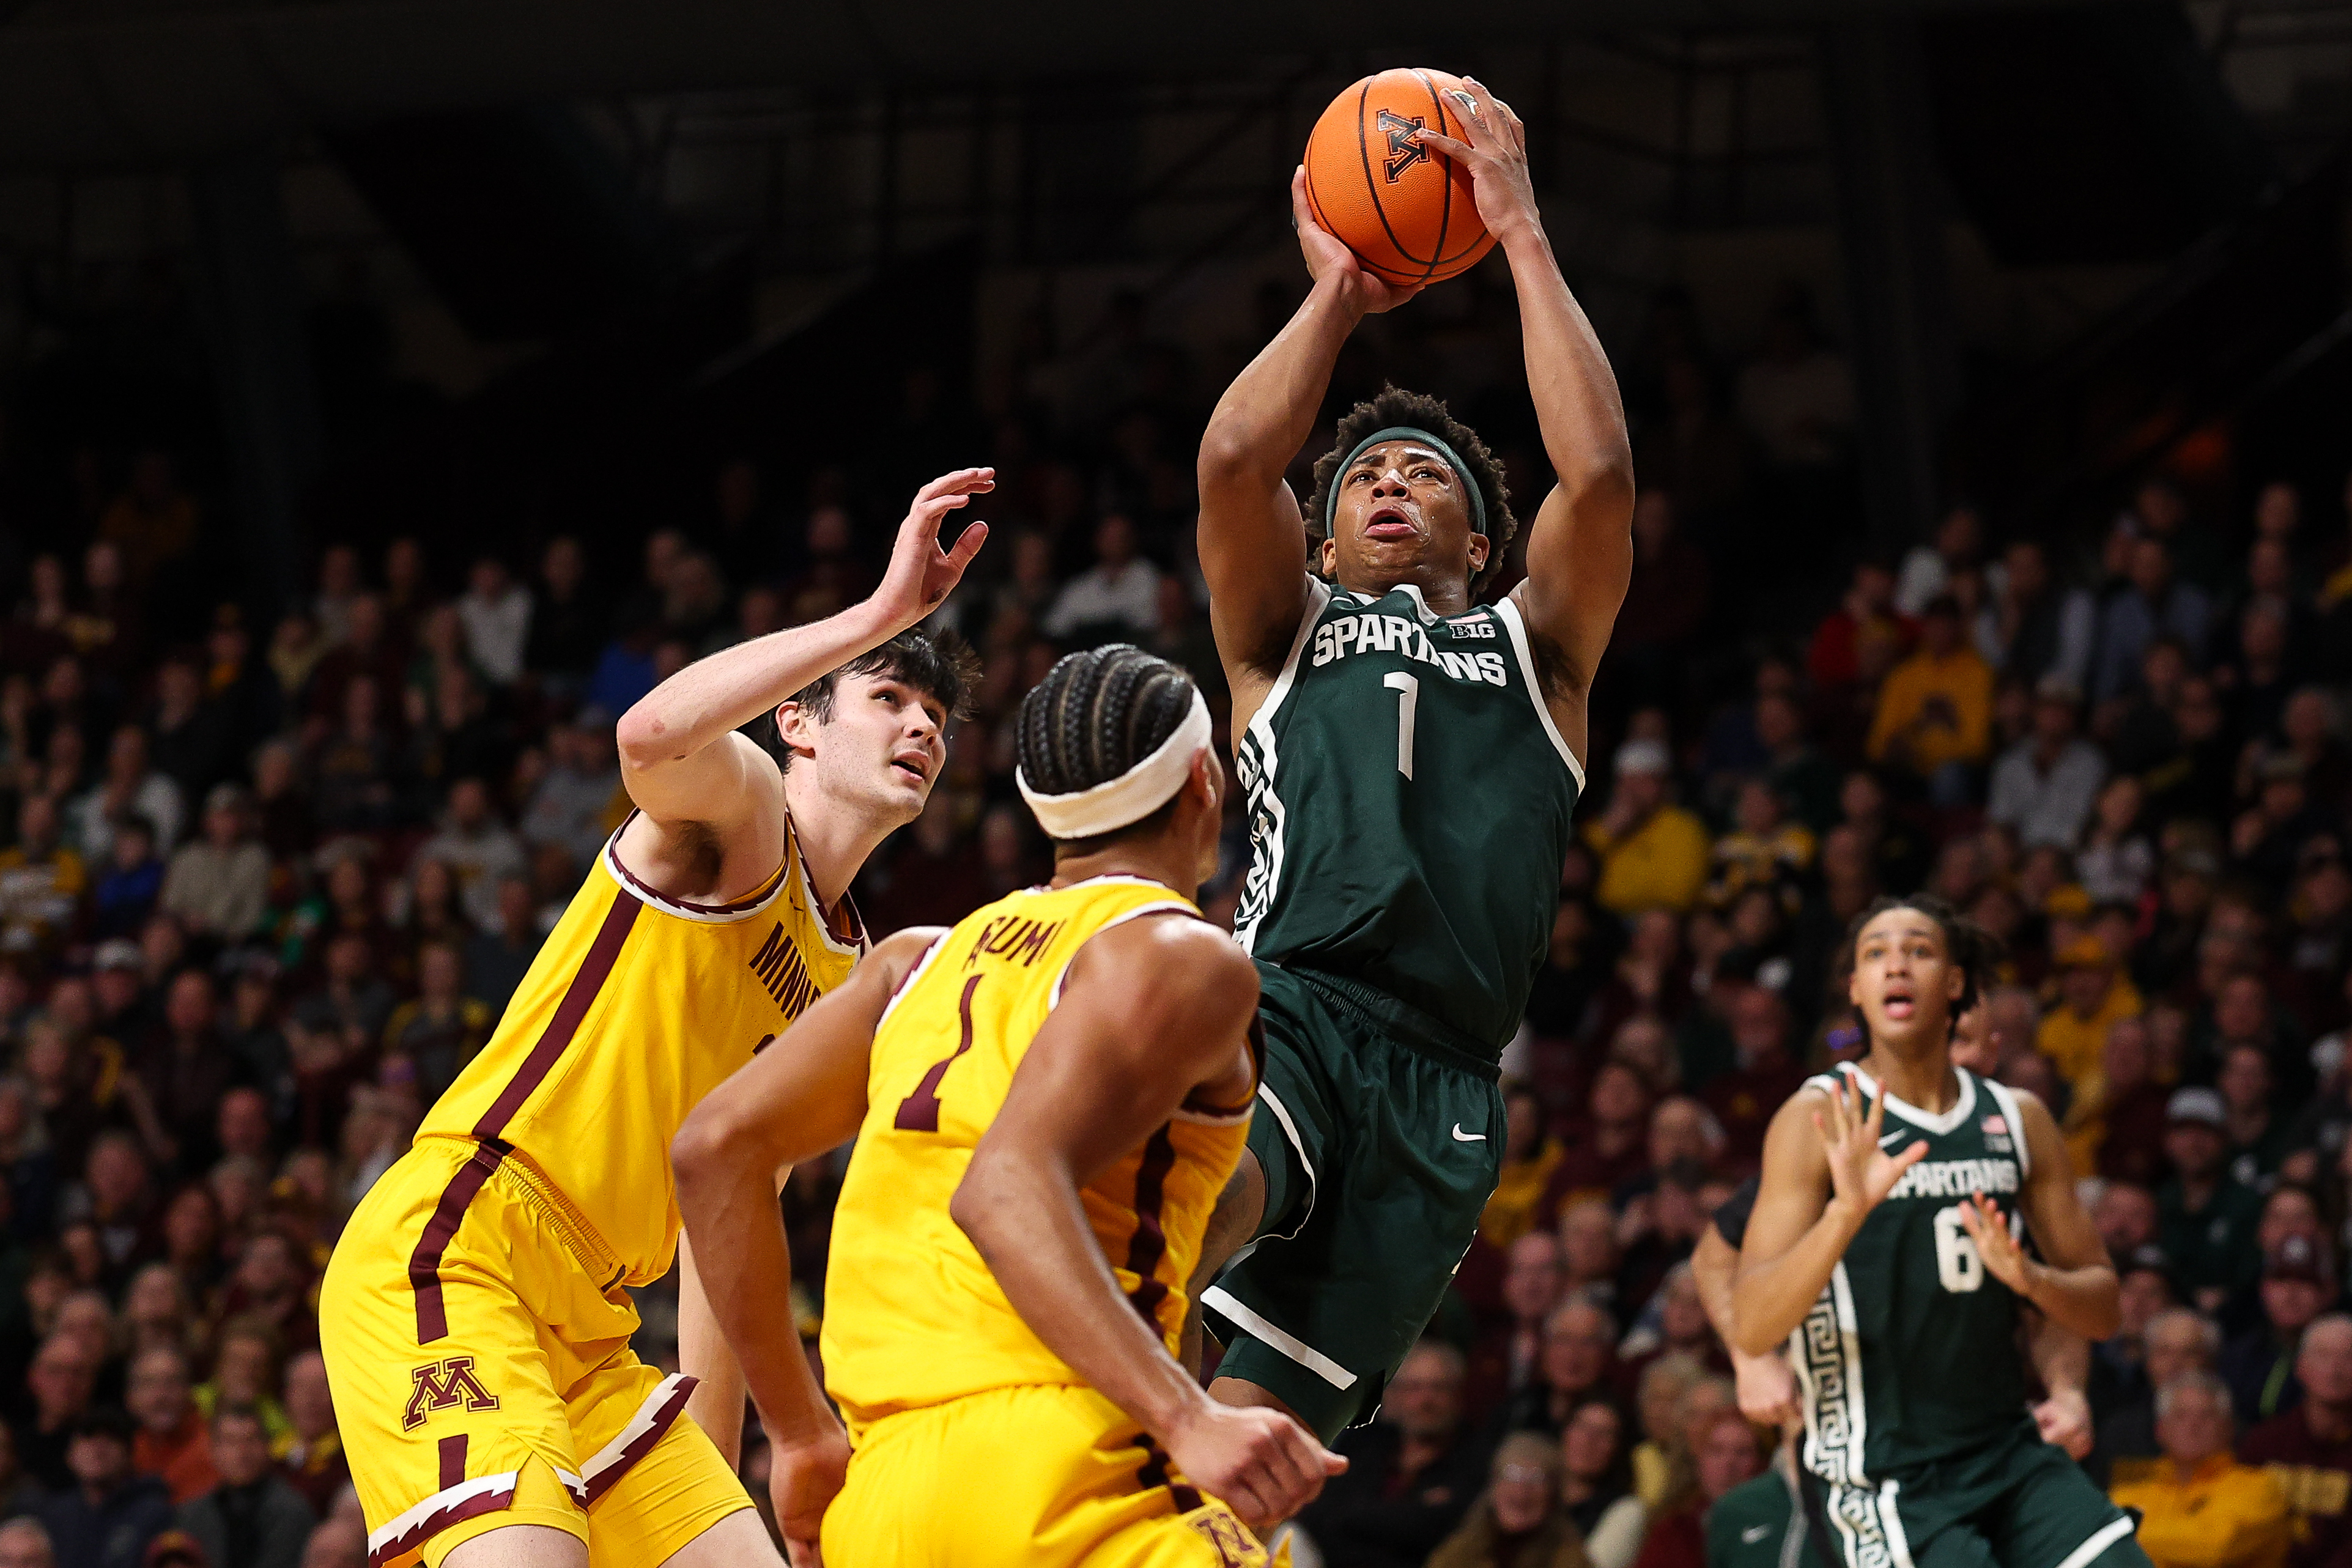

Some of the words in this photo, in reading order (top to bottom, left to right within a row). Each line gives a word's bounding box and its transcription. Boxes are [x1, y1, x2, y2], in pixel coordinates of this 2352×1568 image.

[1312, 613, 1507, 687] SPARTANS
[1383, 671, 1418, 782] 1
[894, 974, 984, 1133] 1
[1933, 1206, 1984, 1293] 6
[402, 1356, 503, 1432] M
